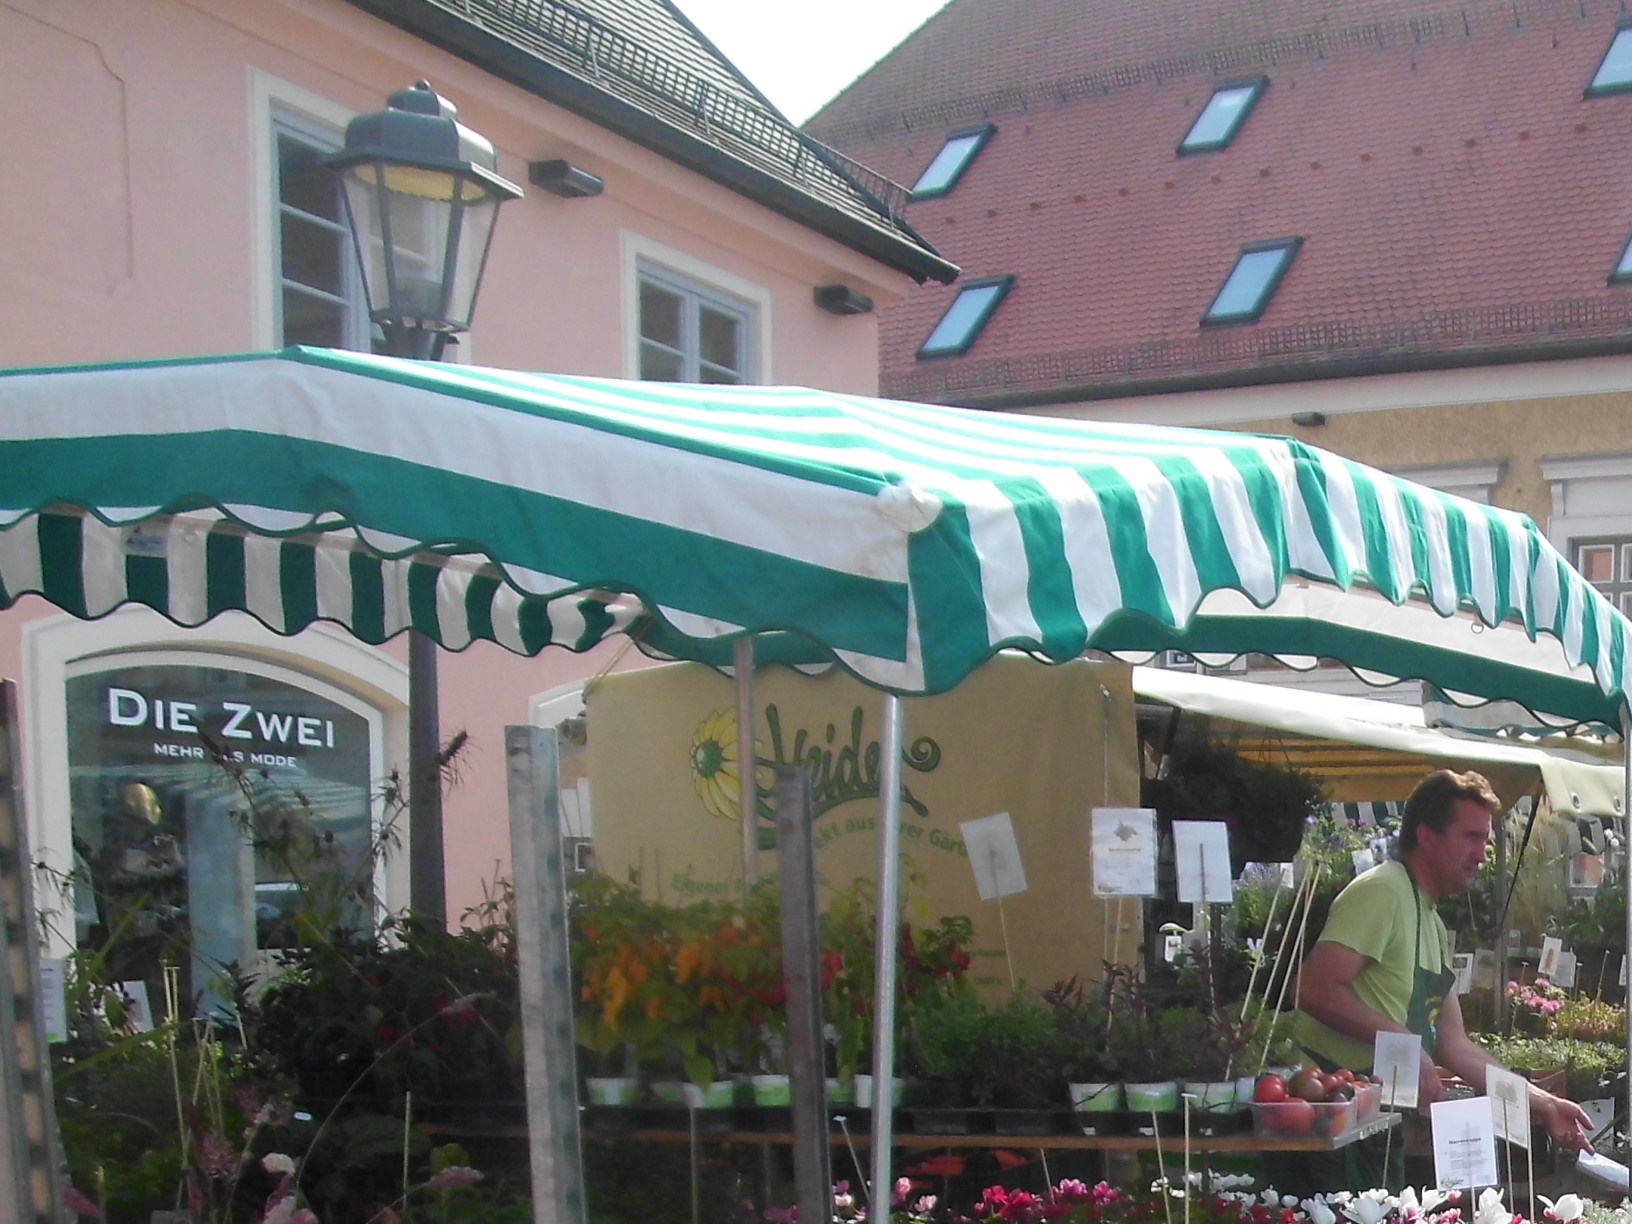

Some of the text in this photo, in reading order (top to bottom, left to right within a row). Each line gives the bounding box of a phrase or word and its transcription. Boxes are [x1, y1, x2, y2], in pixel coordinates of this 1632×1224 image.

[153, 742, 204, 760] MEHR
[250, 753, 298, 768] MODE
[845, 816, 876, 833] aus
